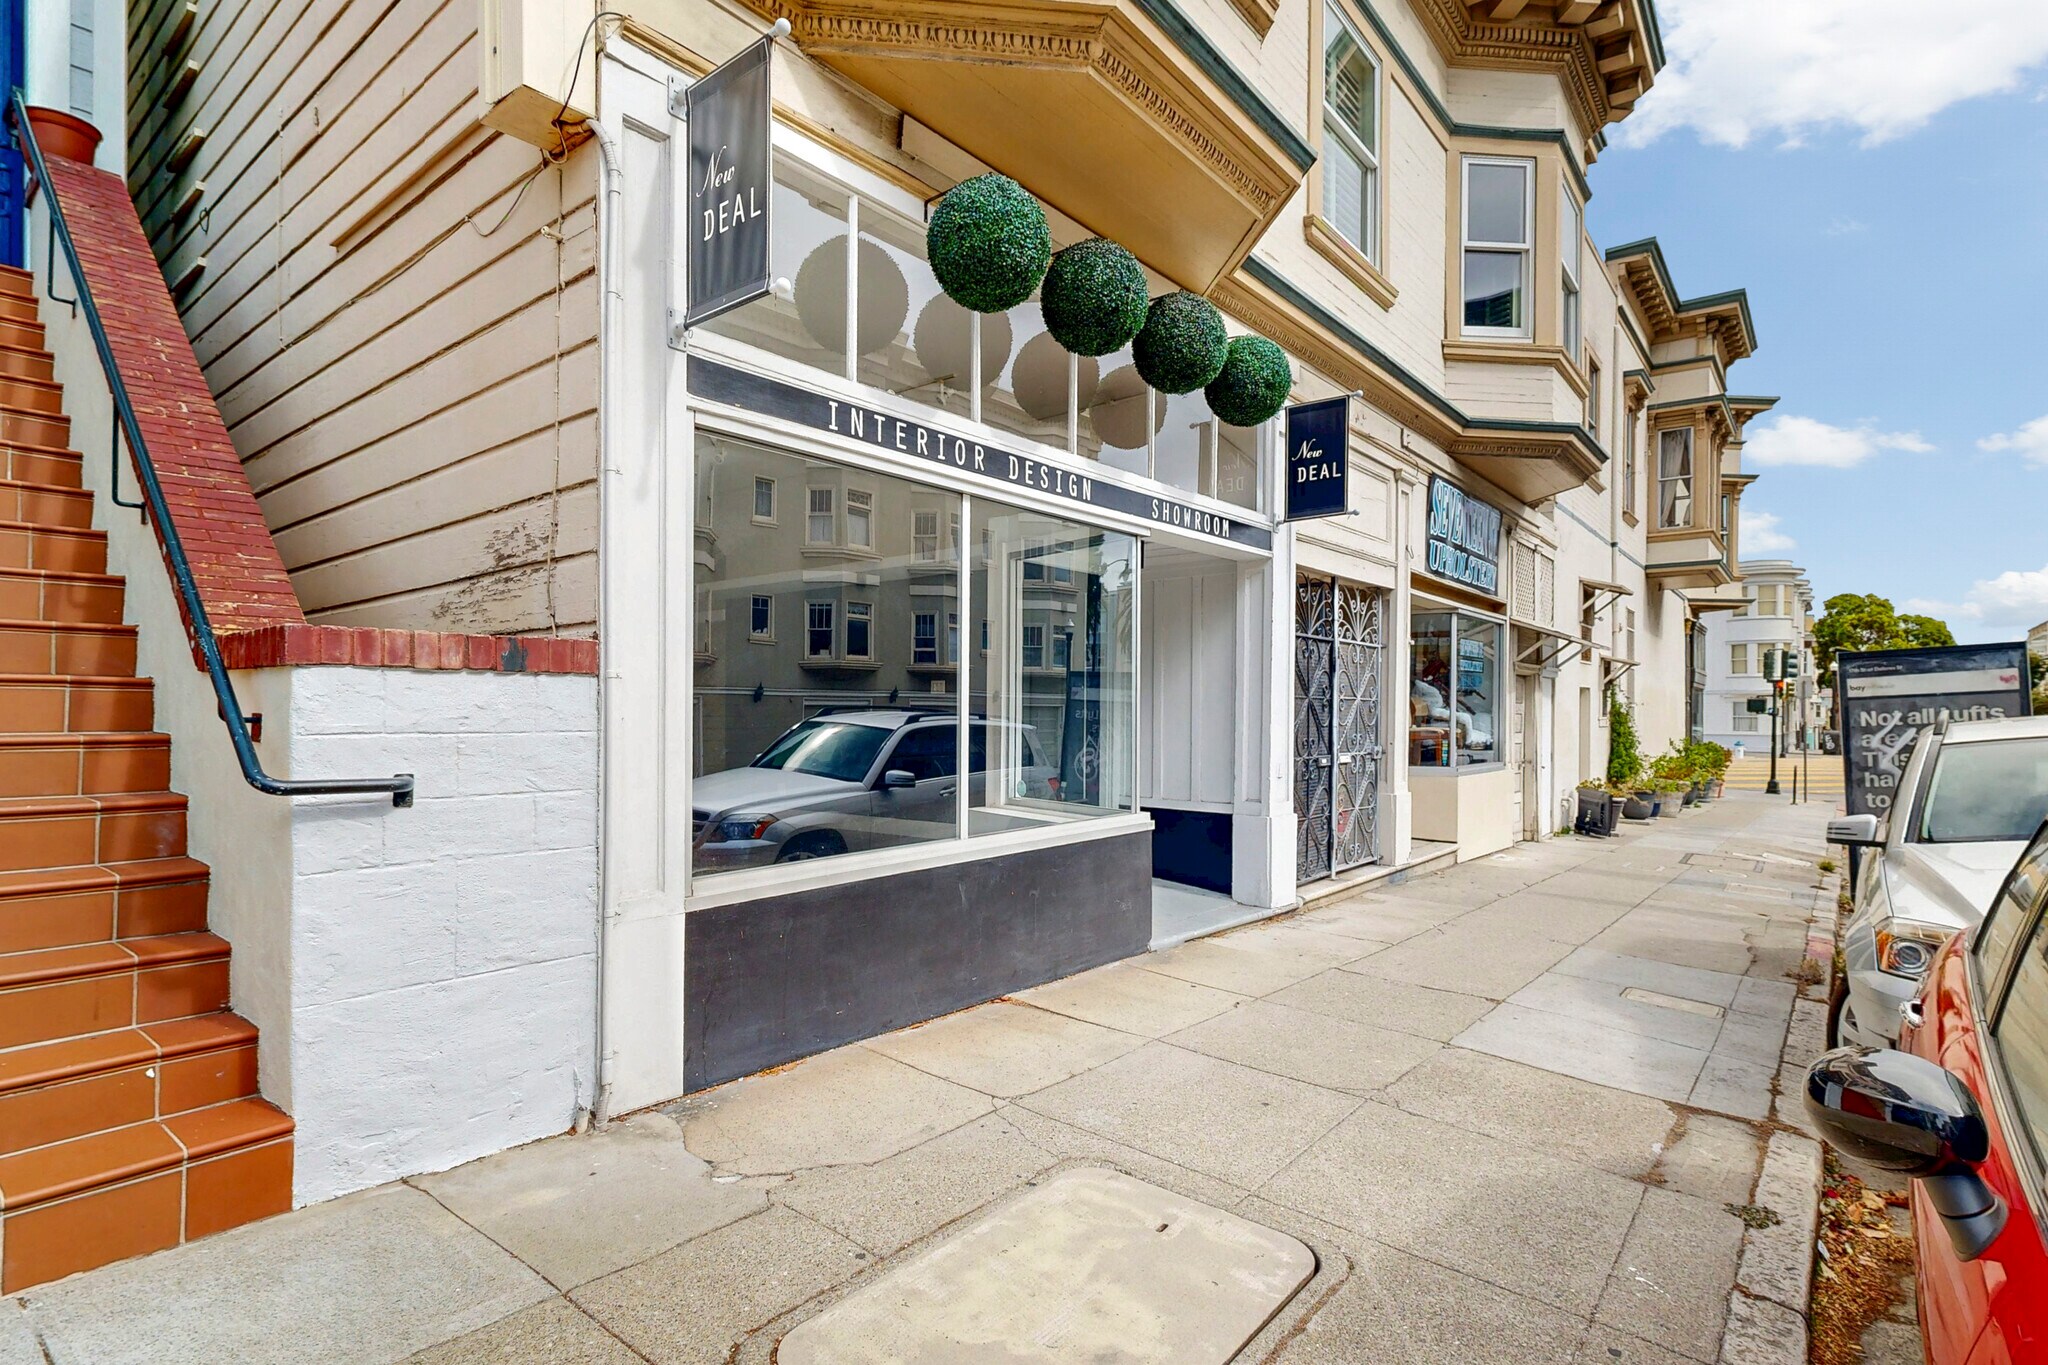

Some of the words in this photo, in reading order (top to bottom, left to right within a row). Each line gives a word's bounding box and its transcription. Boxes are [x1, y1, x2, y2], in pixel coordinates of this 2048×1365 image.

[696, 145, 735, 198] New
[703, 186, 762, 242] DEAL
[1291, 438, 1323, 461] New
[827, 400, 985, 472] INTERIOR
[1008, 454, 1093, 501] DESIGN
[1151, 498, 1231, 538] SHOWROOM
[1297, 461, 1342, 483] DEAL
[1860, 709, 1904, 727] Not
[1907, 707, 1935, 725] all
[1865, 792, 1891, 808] to
